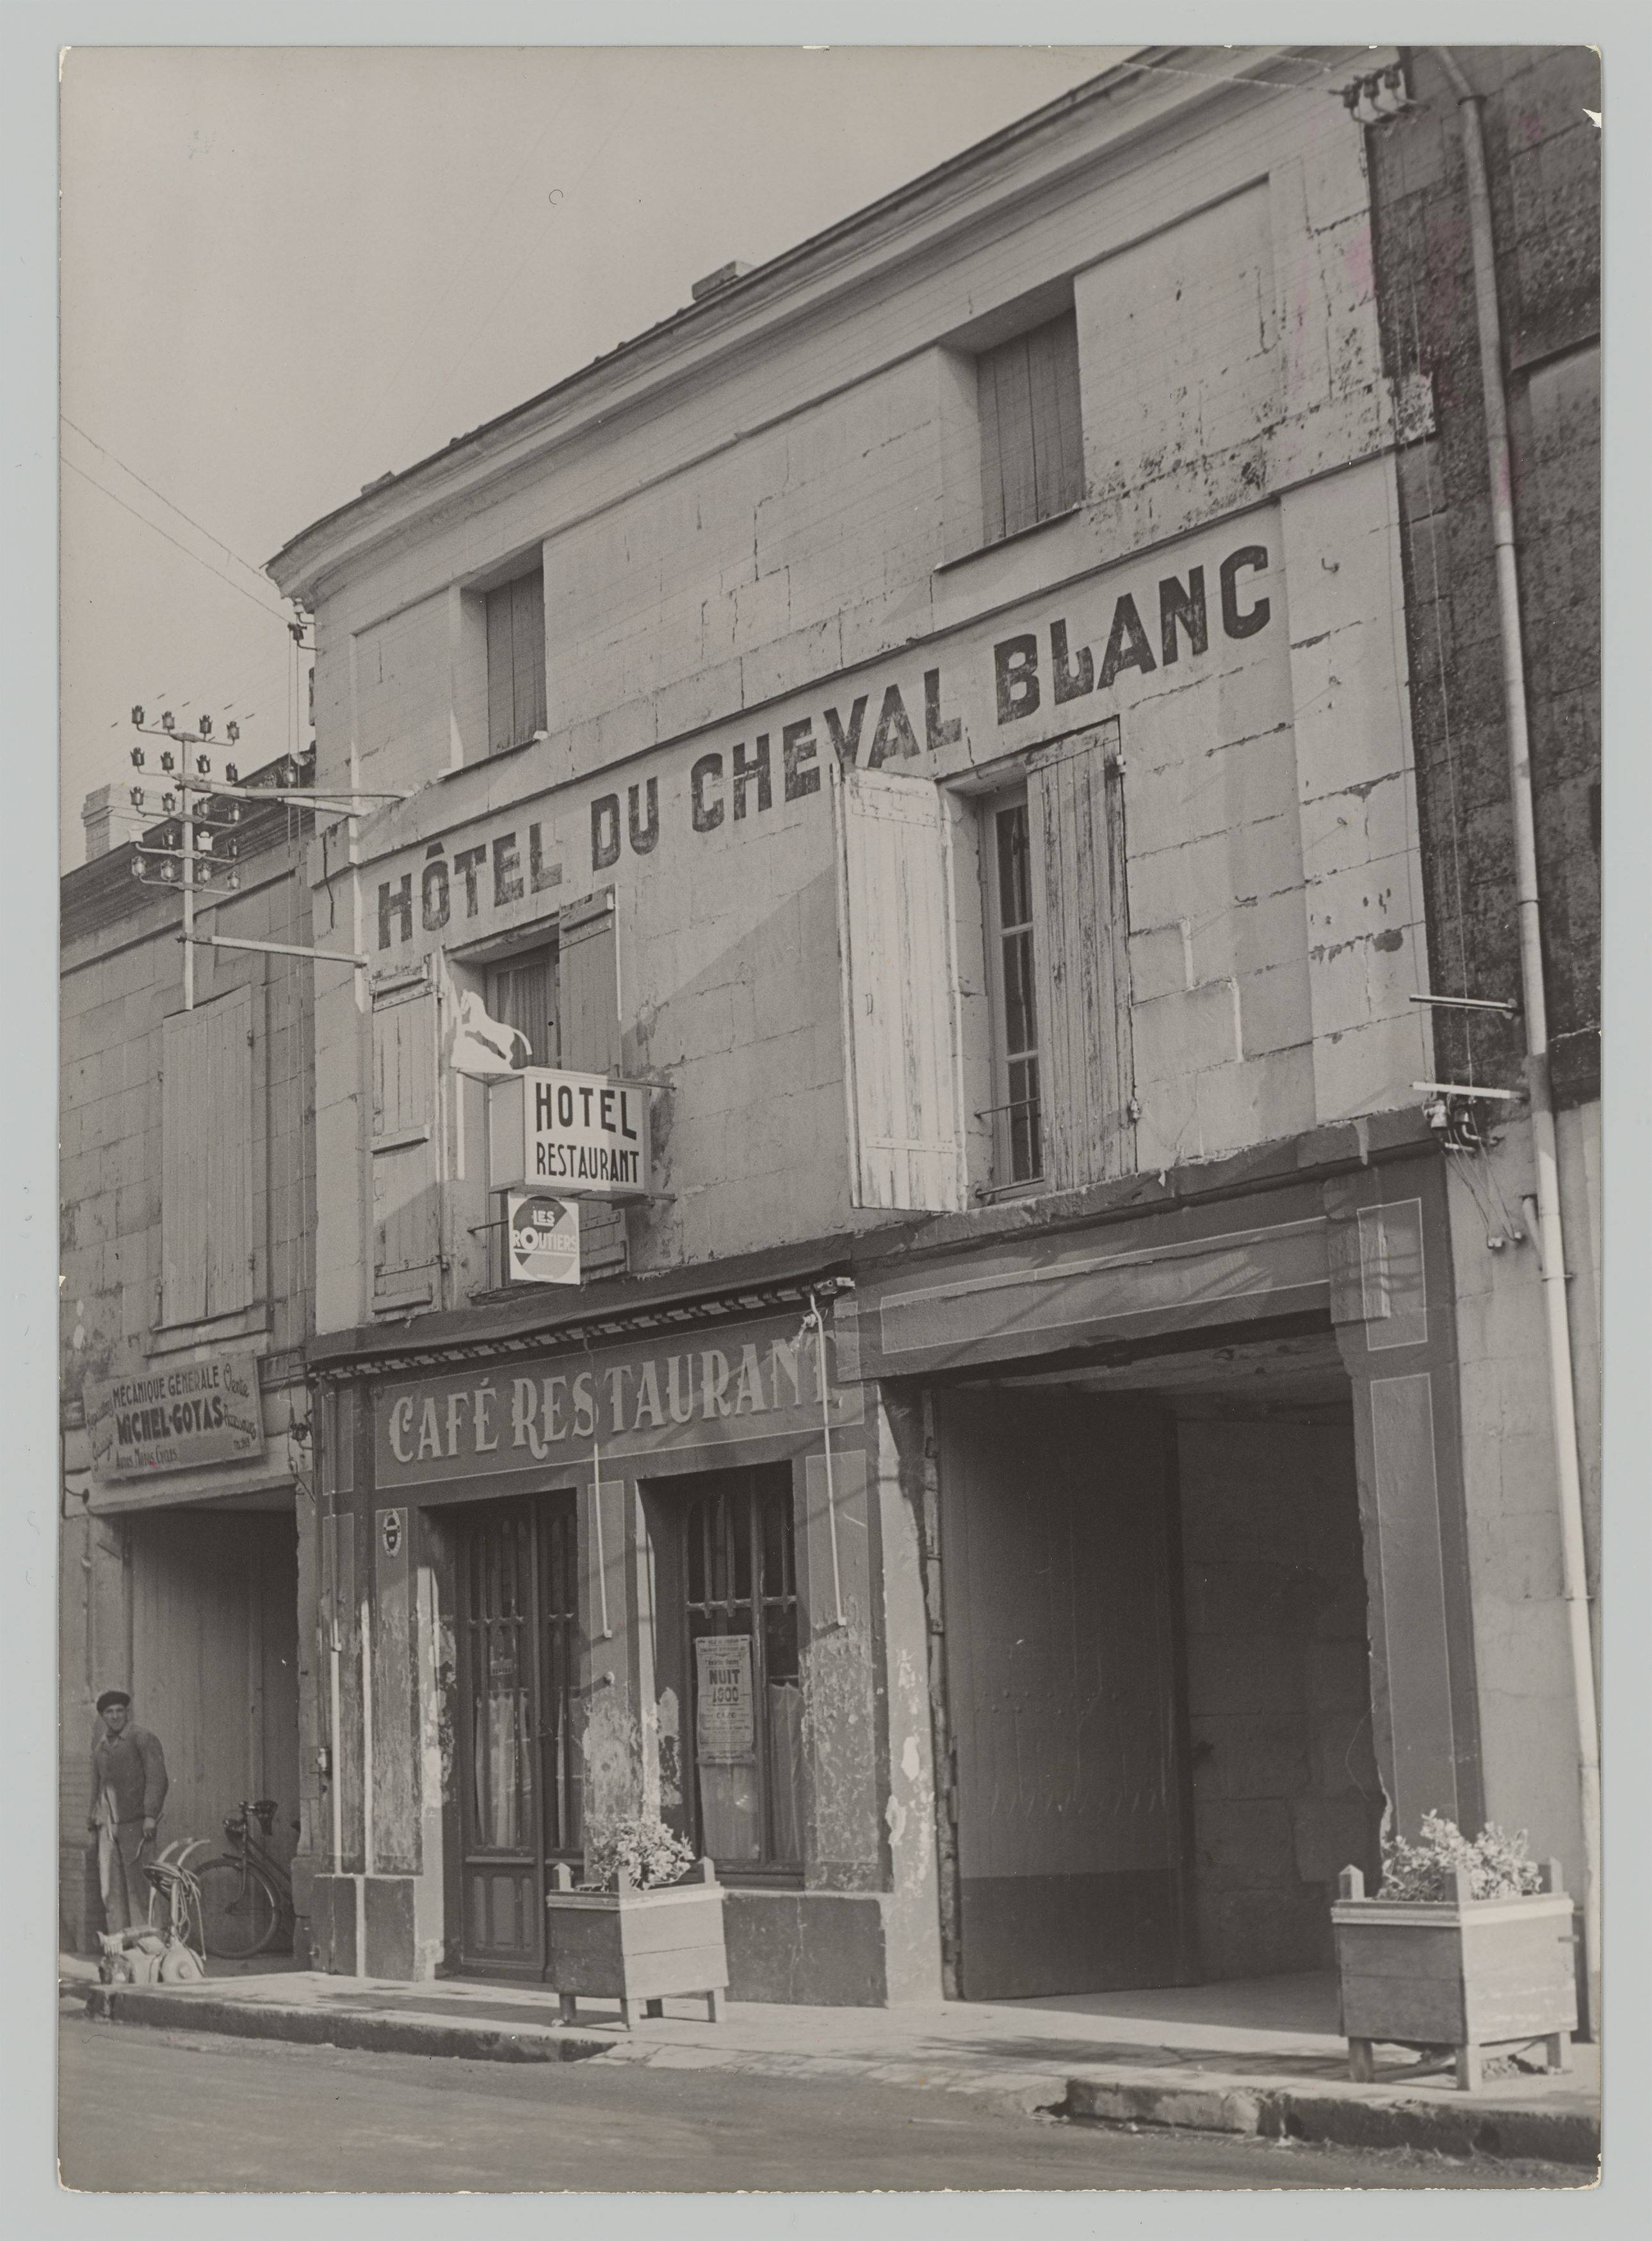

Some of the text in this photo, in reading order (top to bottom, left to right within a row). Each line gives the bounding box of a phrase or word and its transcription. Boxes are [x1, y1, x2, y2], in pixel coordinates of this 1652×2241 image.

[378, 545, 1270, 950] HÔTEL DU CHEVAL BLANC
[536, 1082, 636, 1140] HOTEL
[537, 1142, 639, 1183] RESTAURANT
[533, 1209, 555, 1226] LES
[512, 1227, 576, 1251] ROUTIERS
[389, 1332, 836, 1464] CAFÉ RESTAURANT
[709, 1669, 740, 1685] NUIT
